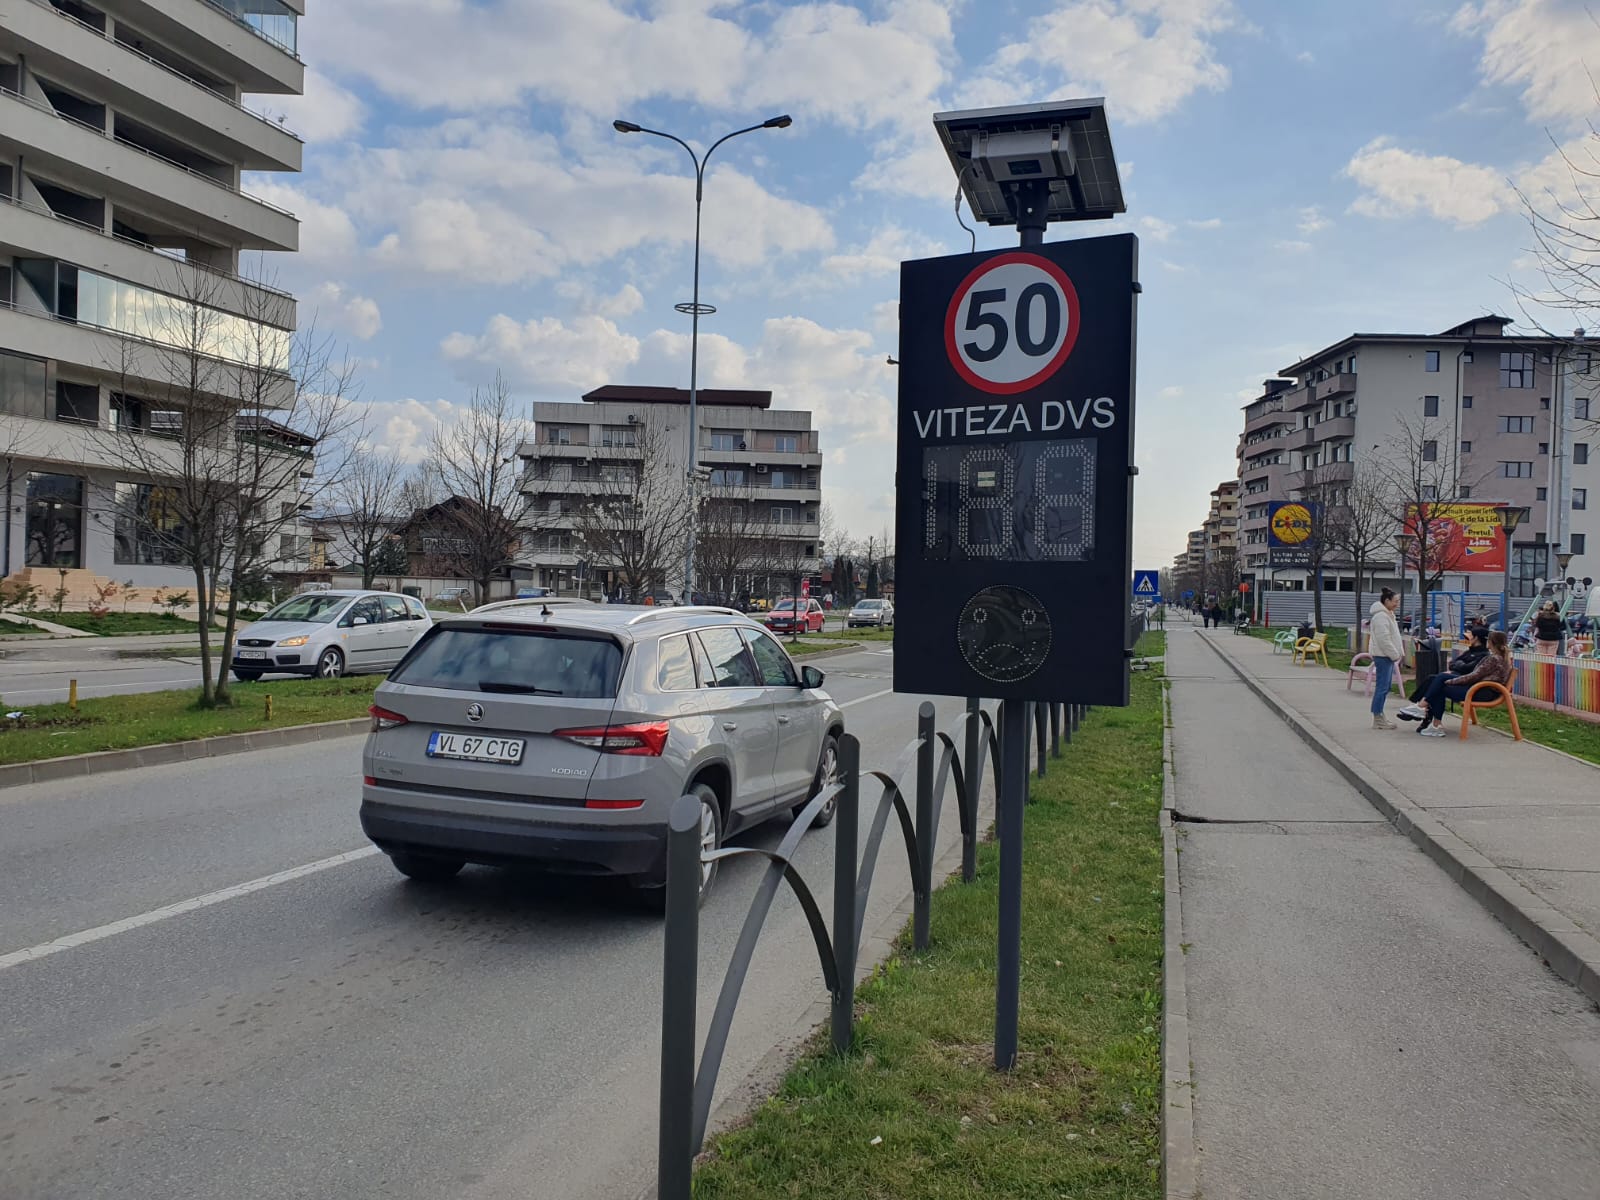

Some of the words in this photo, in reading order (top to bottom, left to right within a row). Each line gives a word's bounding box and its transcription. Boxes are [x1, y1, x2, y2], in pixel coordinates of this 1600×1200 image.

[963, 282, 1061, 362] 50
[913, 403, 1032, 439] VITEZA
[1041, 397, 1115, 431] DVS
[440, 735, 457, 752] VL
[462, 738, 483, 754] 67
[486, 740, 520, 758] CTG
